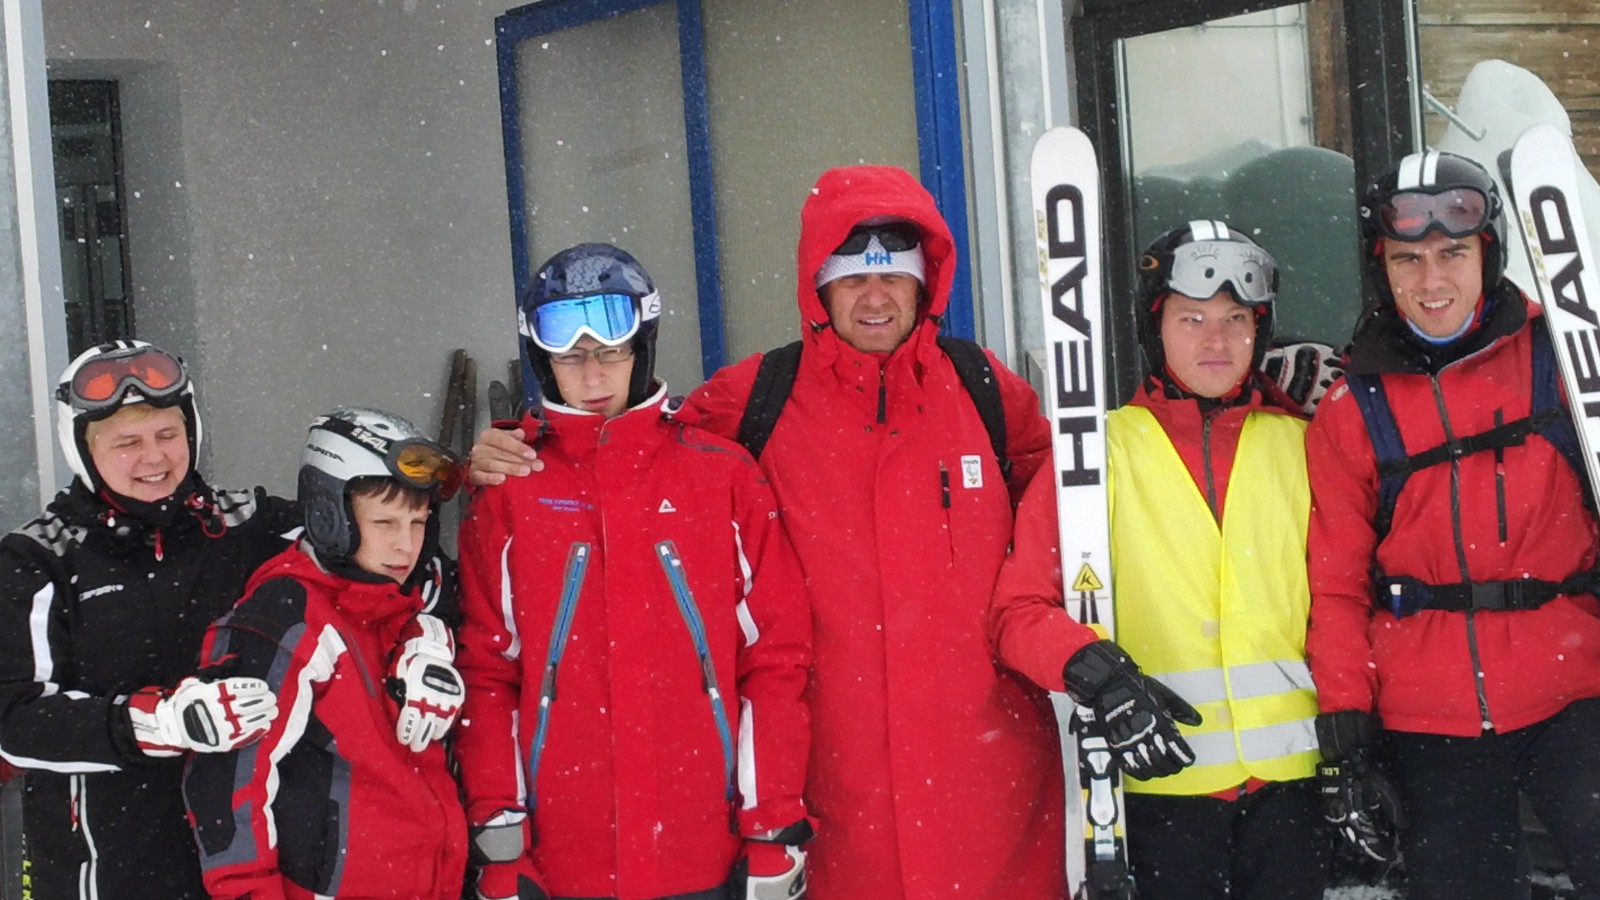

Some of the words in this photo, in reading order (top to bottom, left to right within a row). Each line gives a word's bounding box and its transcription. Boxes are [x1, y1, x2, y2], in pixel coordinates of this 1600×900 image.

[865, 251, 892, 266] HH
[1046, 184, 1100, 487] HEAD
[232, 682, 263, 690] LEKI
